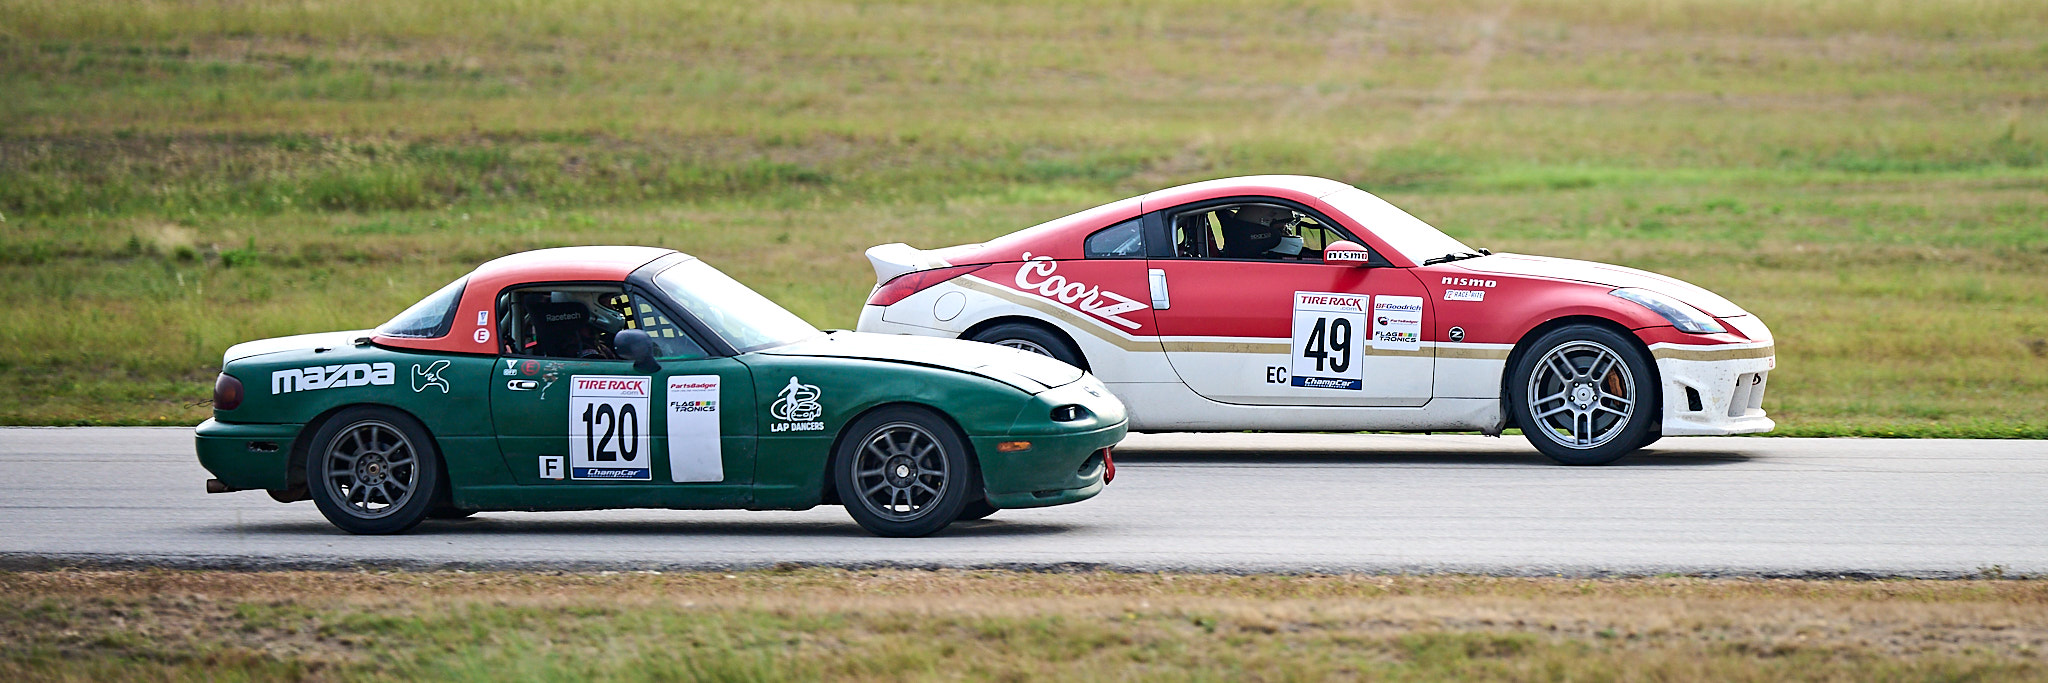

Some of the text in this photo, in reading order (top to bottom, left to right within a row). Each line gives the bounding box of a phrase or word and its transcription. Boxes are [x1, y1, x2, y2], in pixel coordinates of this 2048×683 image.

[1301, 295, 1363, 311] TIRE RACK
[1375, 303, 1421, 311] BFGoodrich
[546, 312, 581, 322] Racetech
[478, 330, 486, 341] E
[1303, 317, 1352, 373] 49
[1266, 366, 1287, 384] EC
[578, 380, 645, 395] TIRE RACK
[1304, 377, 1352, 388] ChampCar
[582, 403, 639, 462] 120
[771, 422, 825, 432] LAP DANCERS
[545, 458, 558, 476] F
[587, 468, 639, 478] ChampCar
